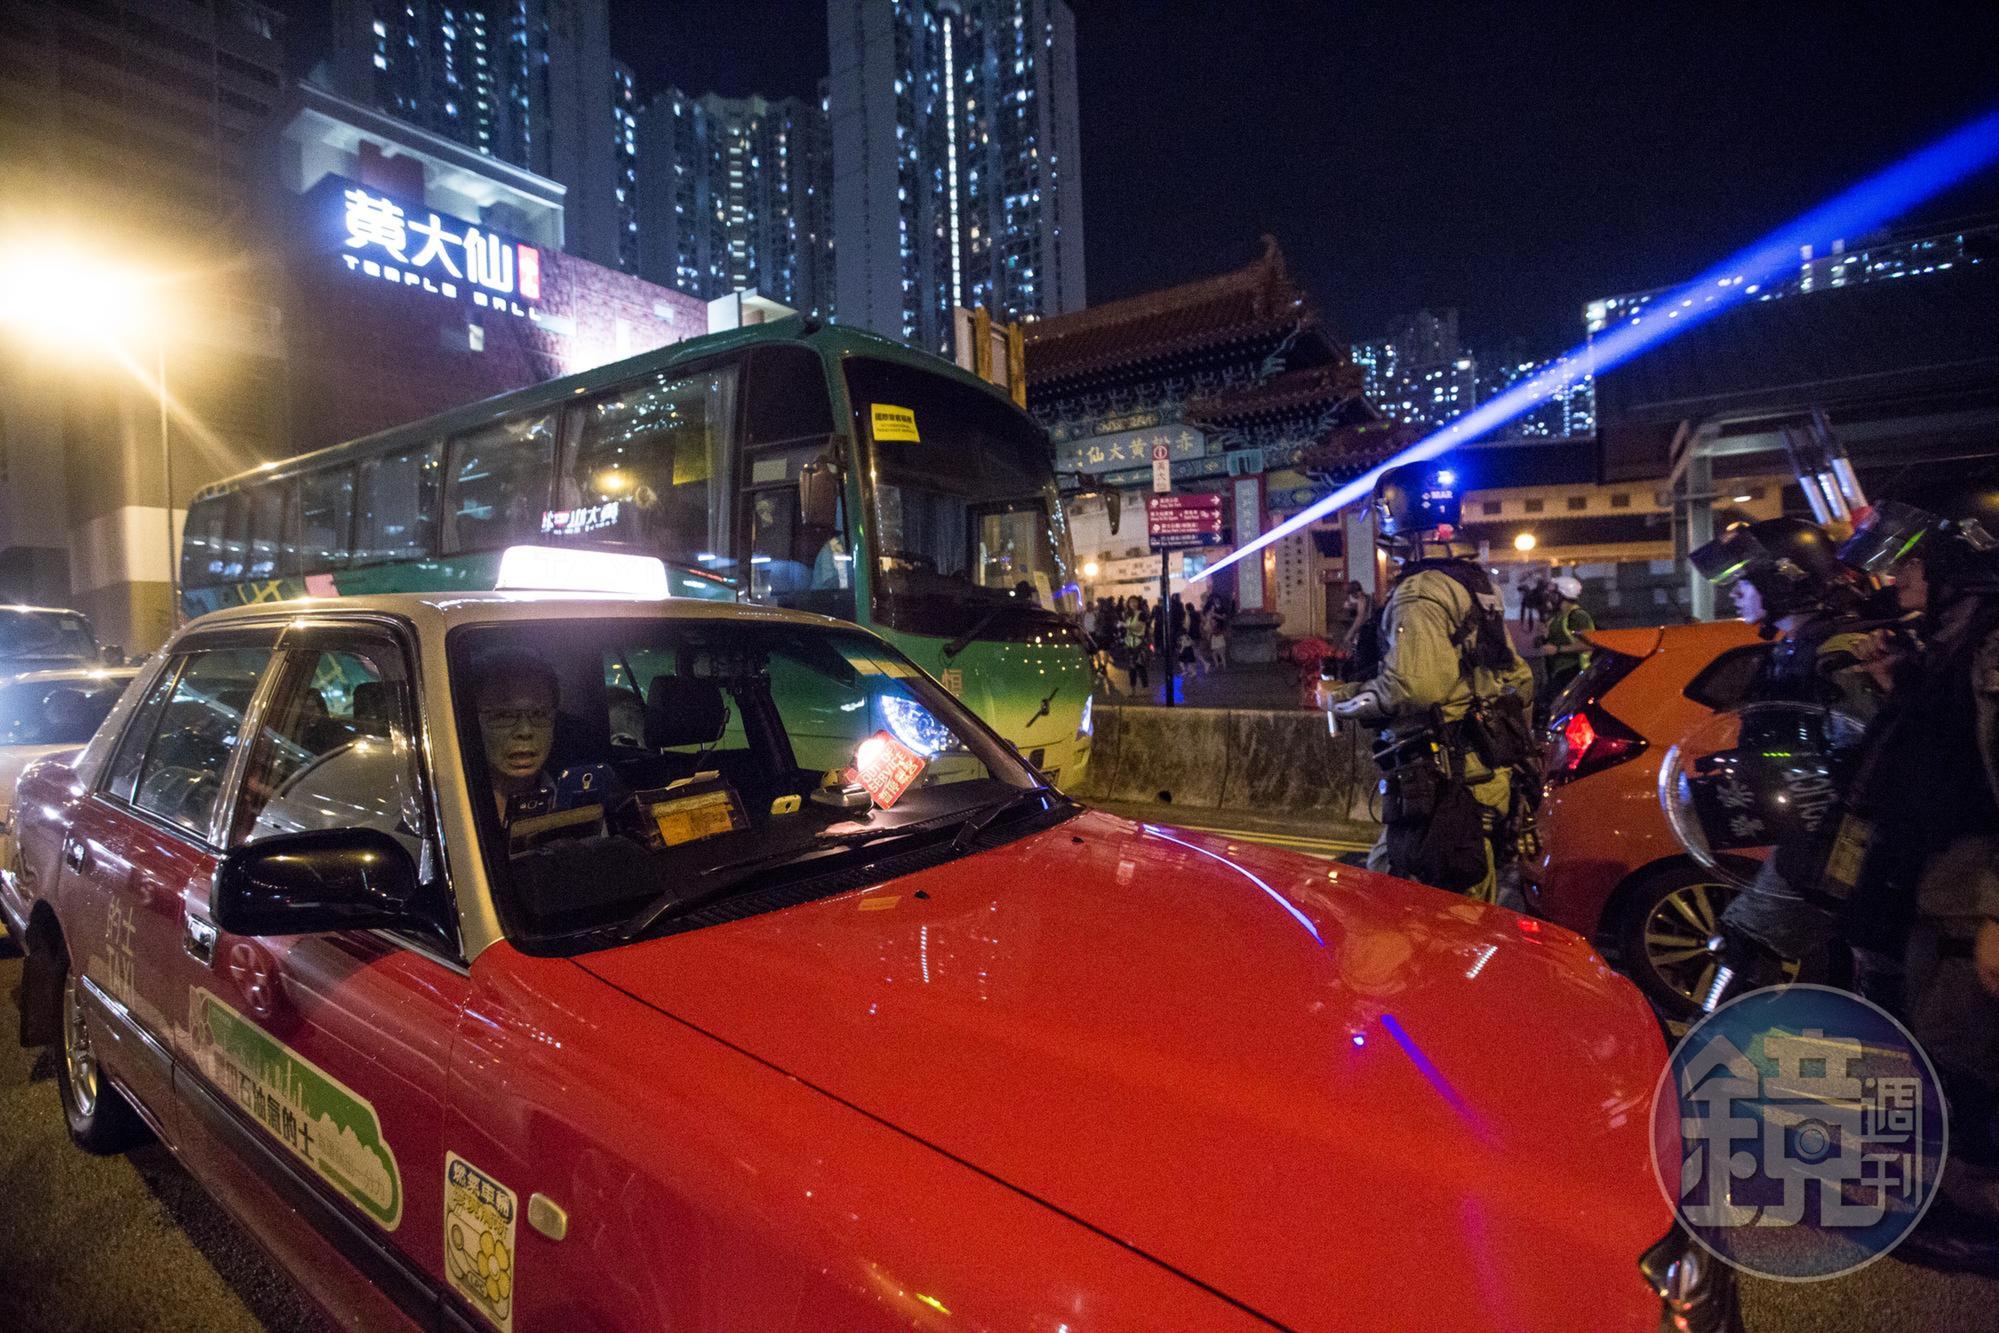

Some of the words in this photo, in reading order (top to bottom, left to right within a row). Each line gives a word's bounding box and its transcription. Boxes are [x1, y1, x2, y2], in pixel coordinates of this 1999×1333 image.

[344, 189, 513, 293] 黃大仙
[343, 254, 457, 298] TEMPLE
[472, 291, 541, 321] MALL
[869, 751, 906, 793] SERVICE
